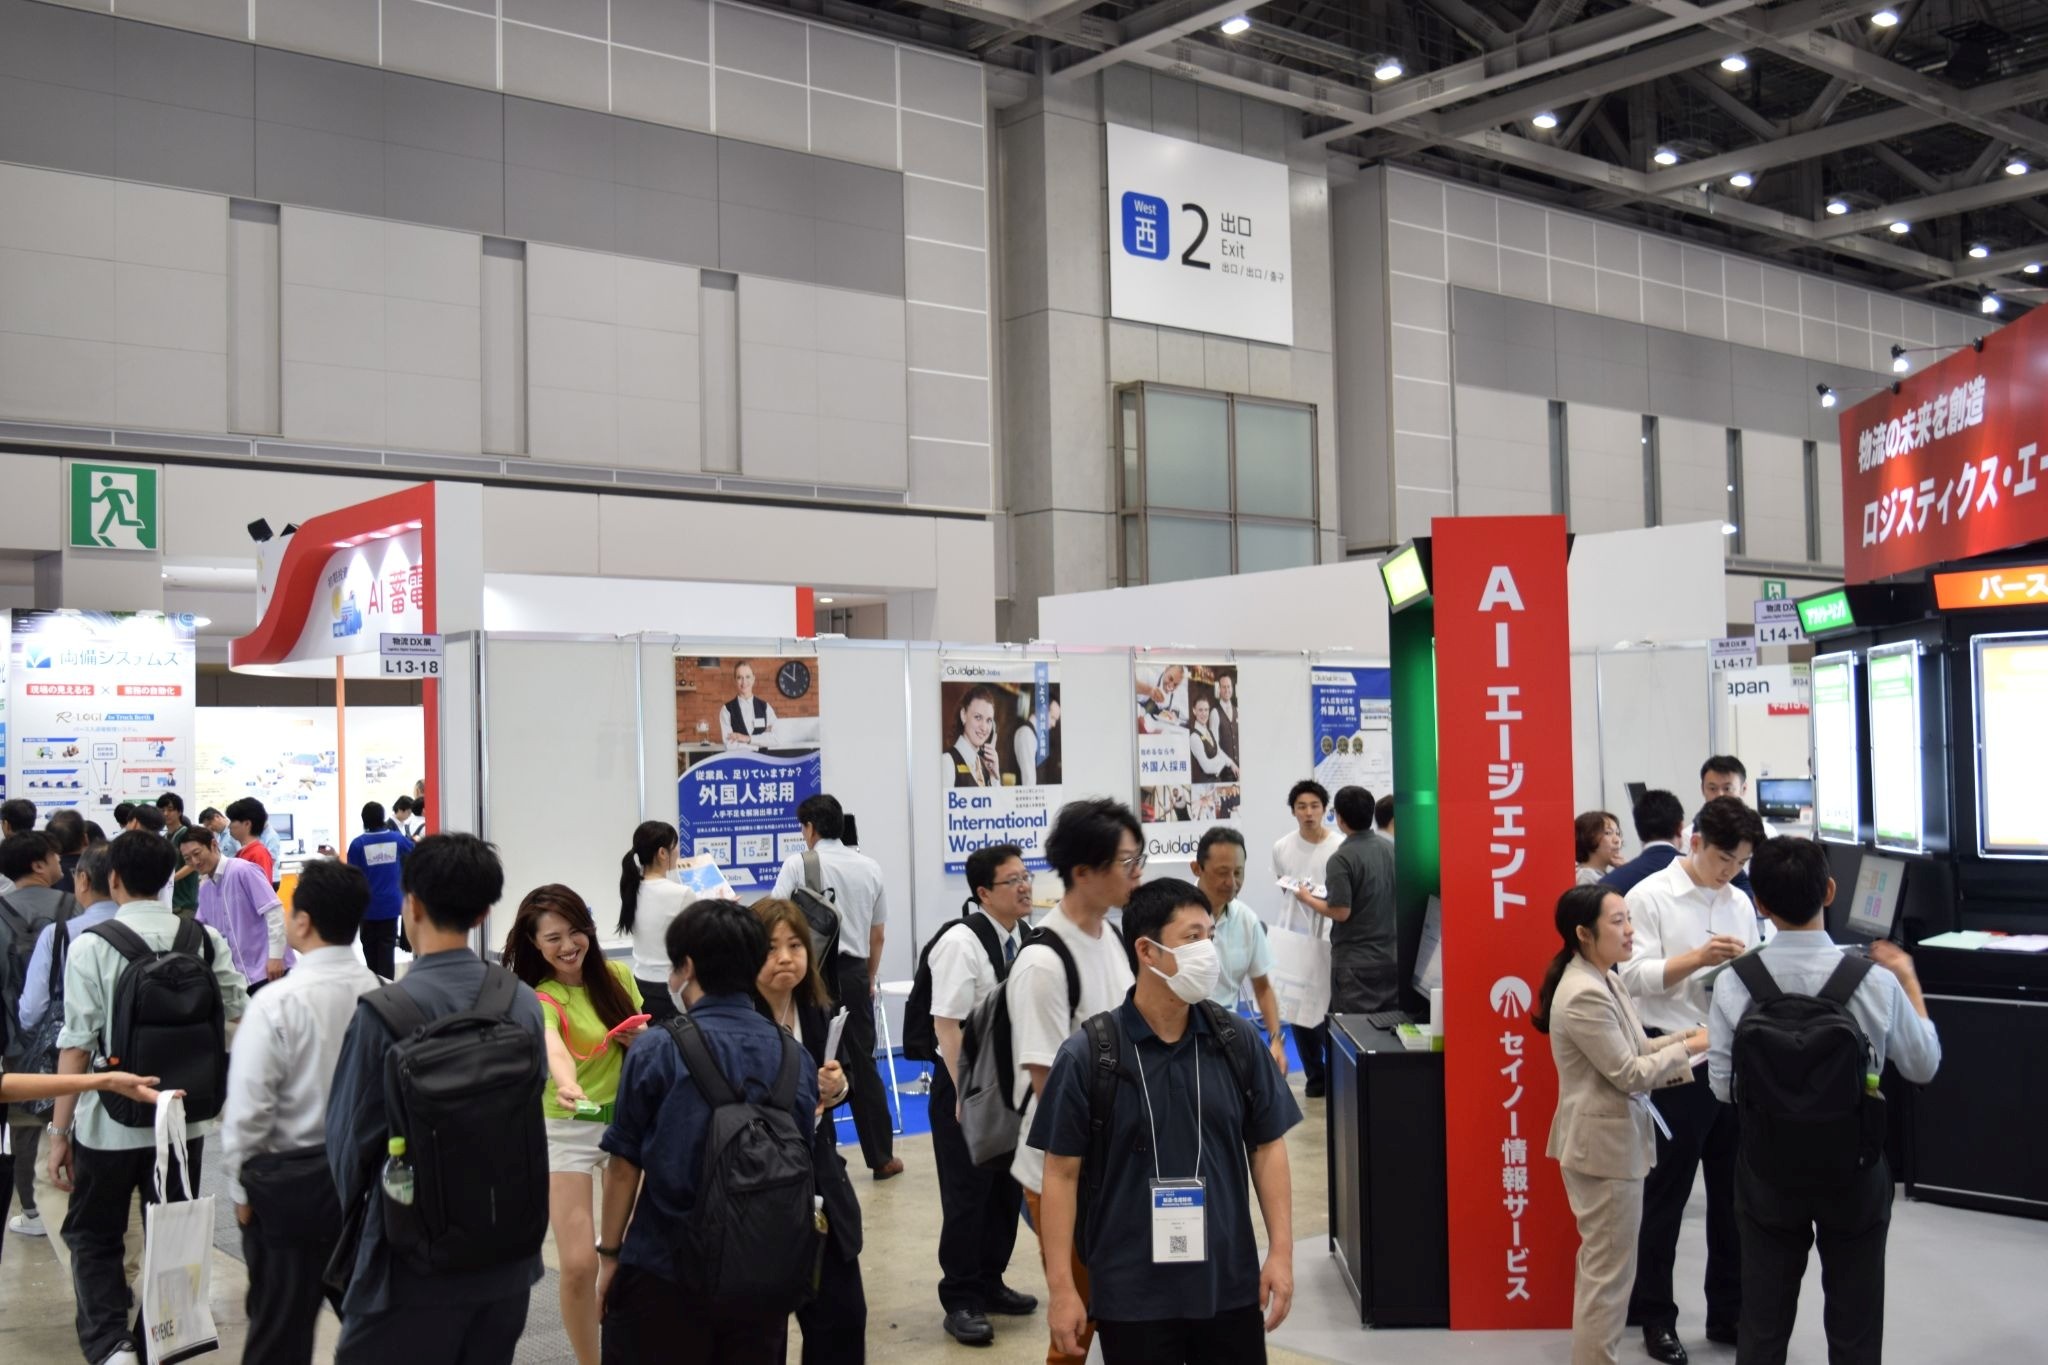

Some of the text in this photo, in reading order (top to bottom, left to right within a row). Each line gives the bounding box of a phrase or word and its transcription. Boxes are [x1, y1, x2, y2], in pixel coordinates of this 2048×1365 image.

[1134, 199, 1157, 216] West
[1221, 212, 1252, 237] 出口
[1135, 216, 1157, 254] 西
[1182, 203, 1211, 270] 2
[1221, 239, 1245, 260] Exit
[1222, 262, 1238, 275] 出口
[1858, 374, 1986, 474] 物流の未来を創造
[1978, 573, 2048, 600] バース
[1766, 603, 1796, 612] 物流DX
[1760, 626, 1803, 643] L14-1
[385, 660, 438, 674] L13-18
[947, 665, 986, 676] Guidable
[1714, 657, 1752, 670] L14-17
[1728, 679, 1770, 697] apan
[695, 767, 802, 782] 従業員、足りていますか？
[1141, 761, 1187, 772] 外国人採用
[699, 782, 795, 806] 外国人採用
[948, 791, 992, 809] Be an
[948, 809, 1047, 832] International
[1149, 835, 1201, 855] Guidab
[1499, 1030, 1531, 1301] セイノー情報サービス
